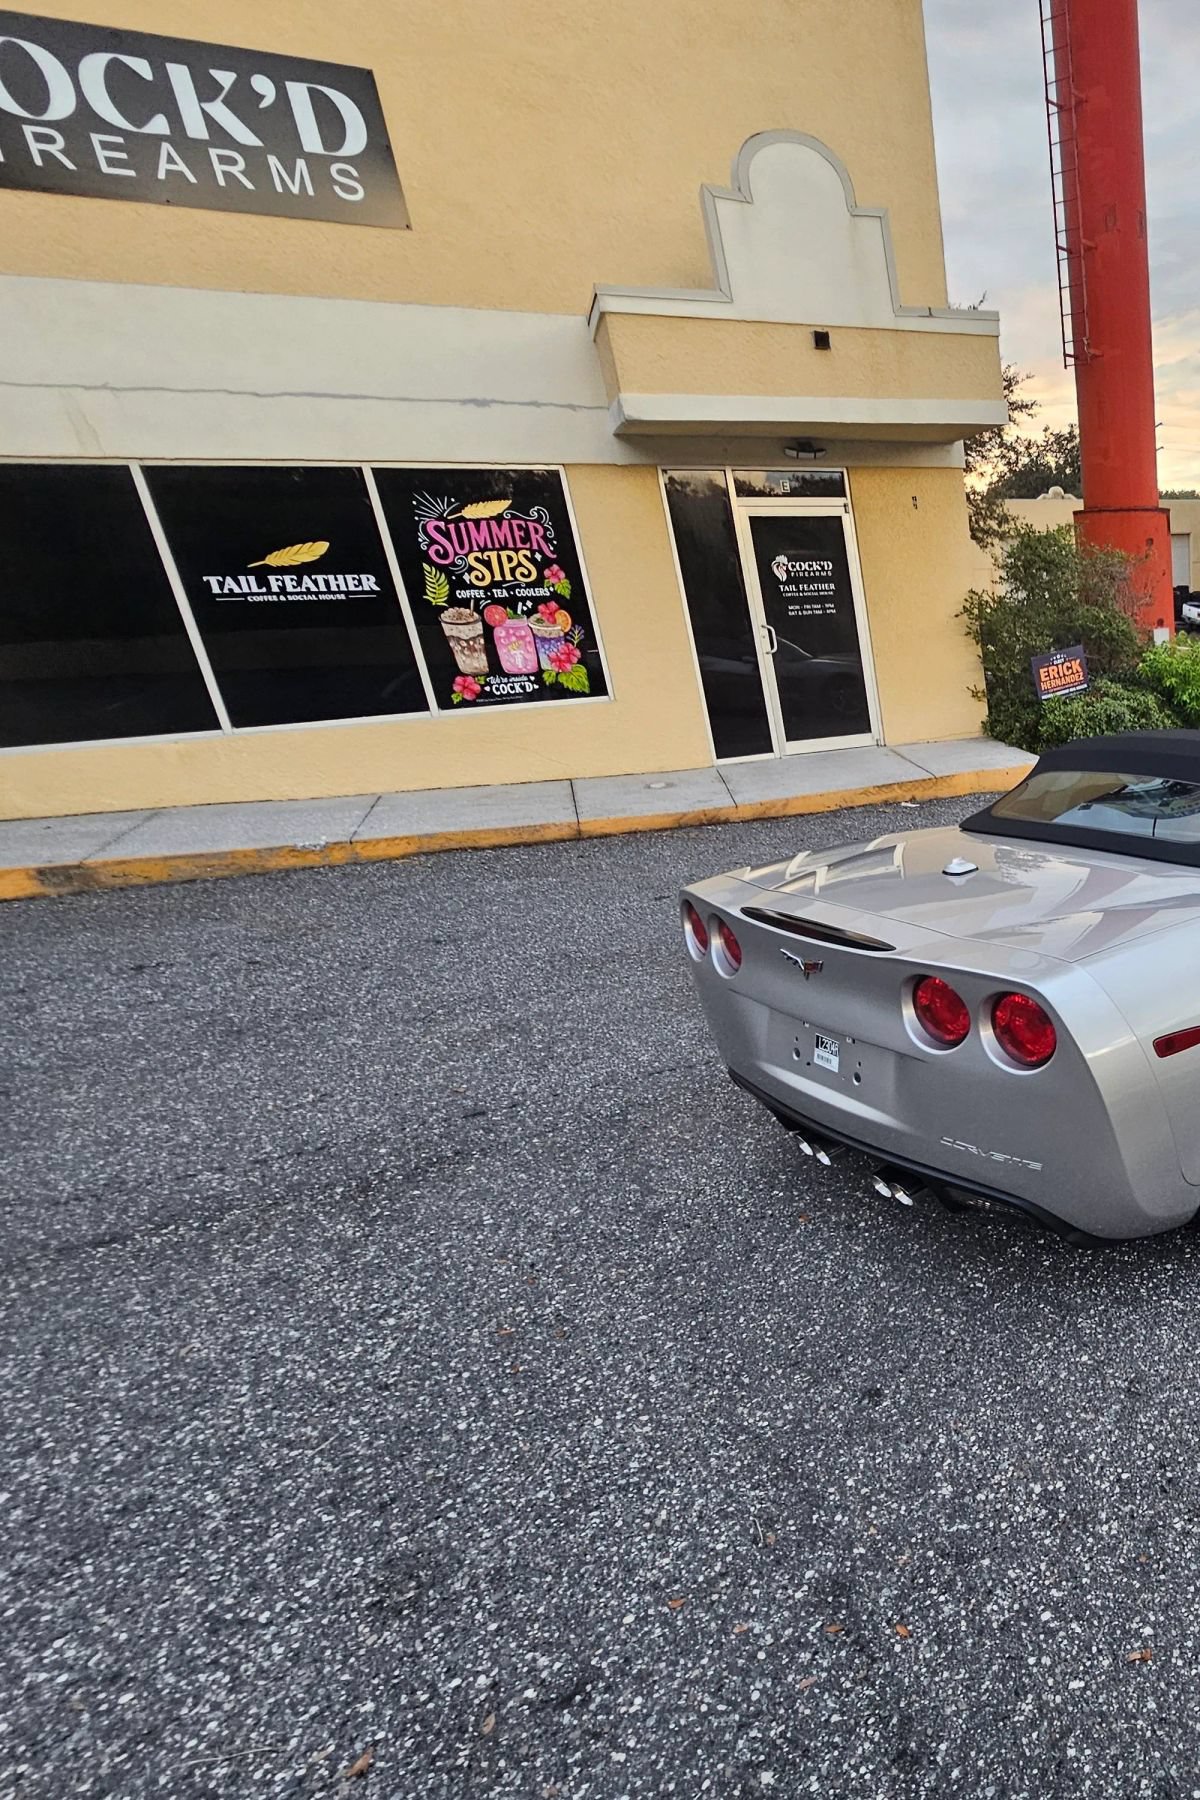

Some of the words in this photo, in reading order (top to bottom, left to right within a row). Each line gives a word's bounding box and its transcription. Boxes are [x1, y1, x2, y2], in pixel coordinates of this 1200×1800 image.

[0, 124, 366, 202] REARMS
[780, 480, 790, 492] E
[426, 518, 557, 565] SUMMER
[467, 550, 538, 587] SIPS
[788, 560, 833, 571] COCK'D
[203, 575, 266, 594] TAIL
[267, 574, 381, 594] FEATHER
[456, 589, 486, 598] COFFEE
[492, 588, 509, 598] TEA
[515, 587, 551, 597] COOLERS
[778, 584, 798, 592] TAIL
[799, 583, 836, 591] FEATHER
[1040, 659, 1082, 681] ERICK
[492, 682, 534, 695] COCK'D
[1041, 671, 1084, 691] HERNANDEZ
